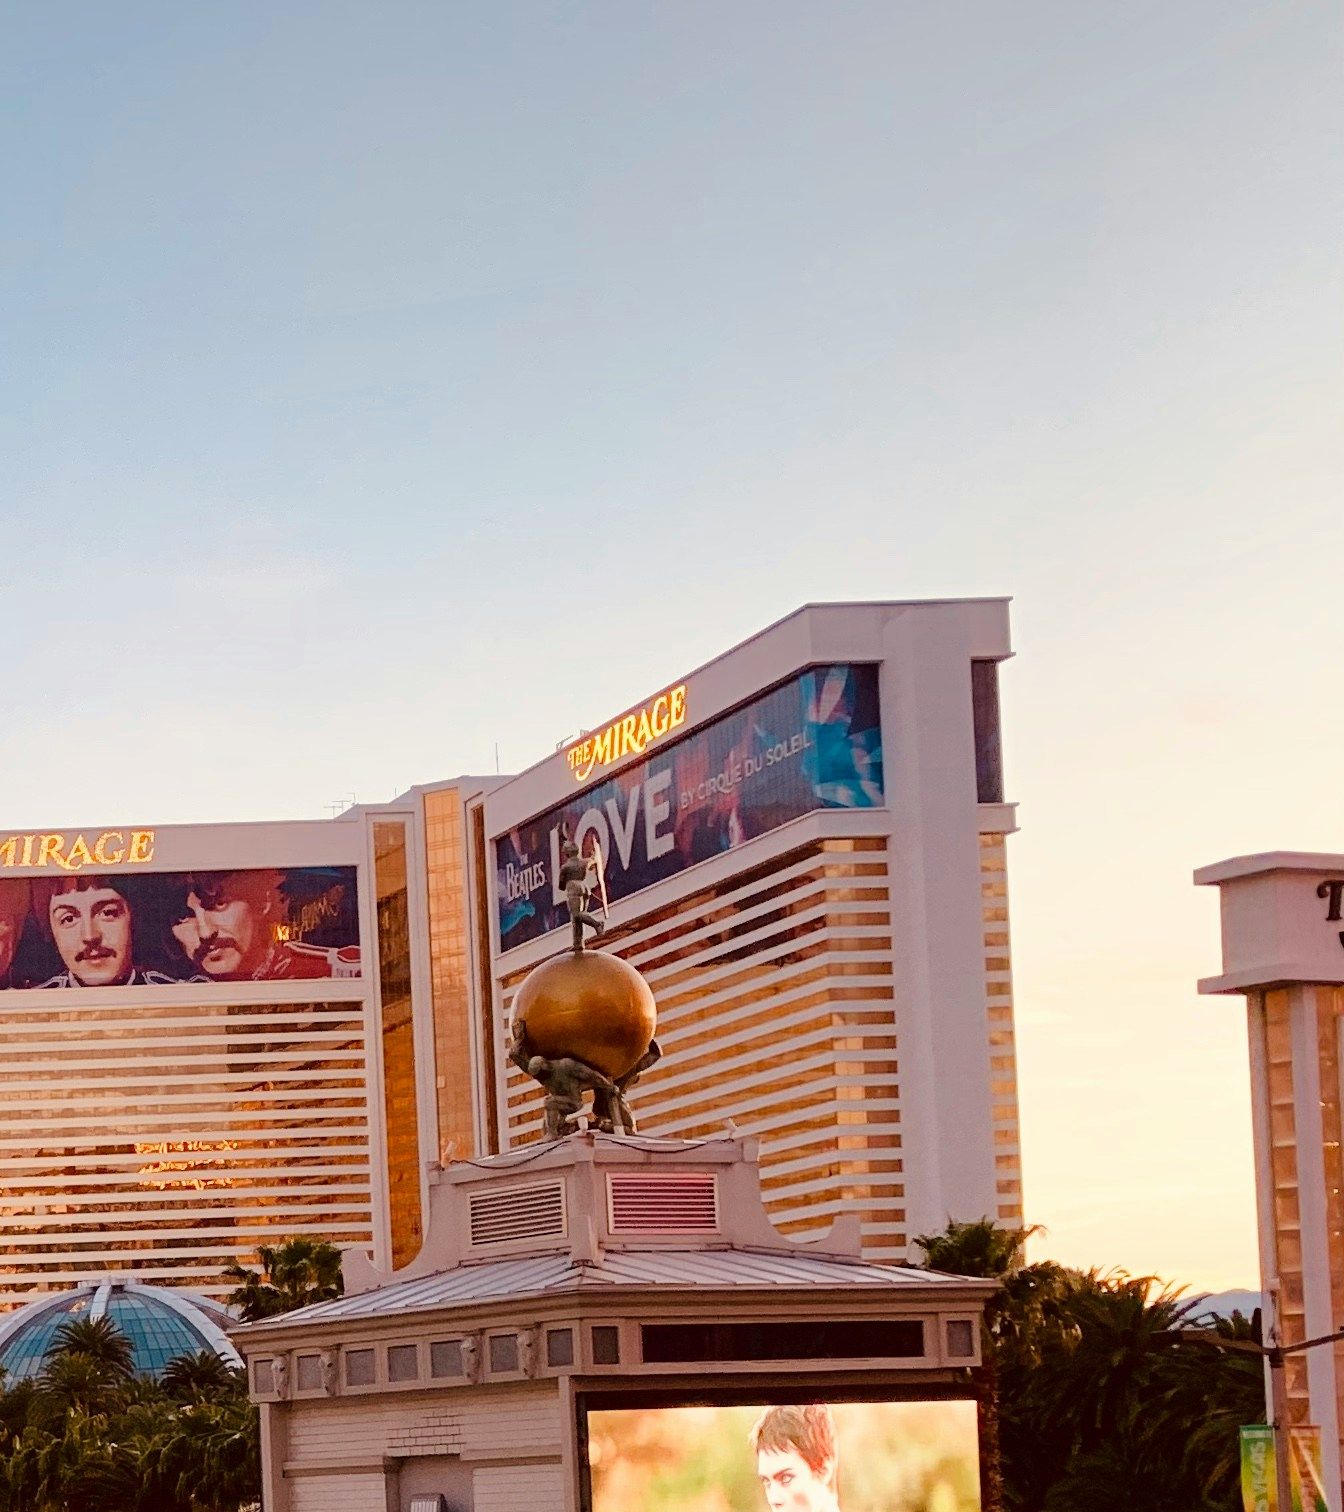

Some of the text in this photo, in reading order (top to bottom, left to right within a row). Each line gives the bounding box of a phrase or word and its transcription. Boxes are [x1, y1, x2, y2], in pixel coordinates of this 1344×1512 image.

[567, 685, 686, 781] THE MIRAGE
[698, 765, 742, 799] CIRQUE
[745, 756, 763, 777] DU
[766, 730, 812, 766] SOLEIL
